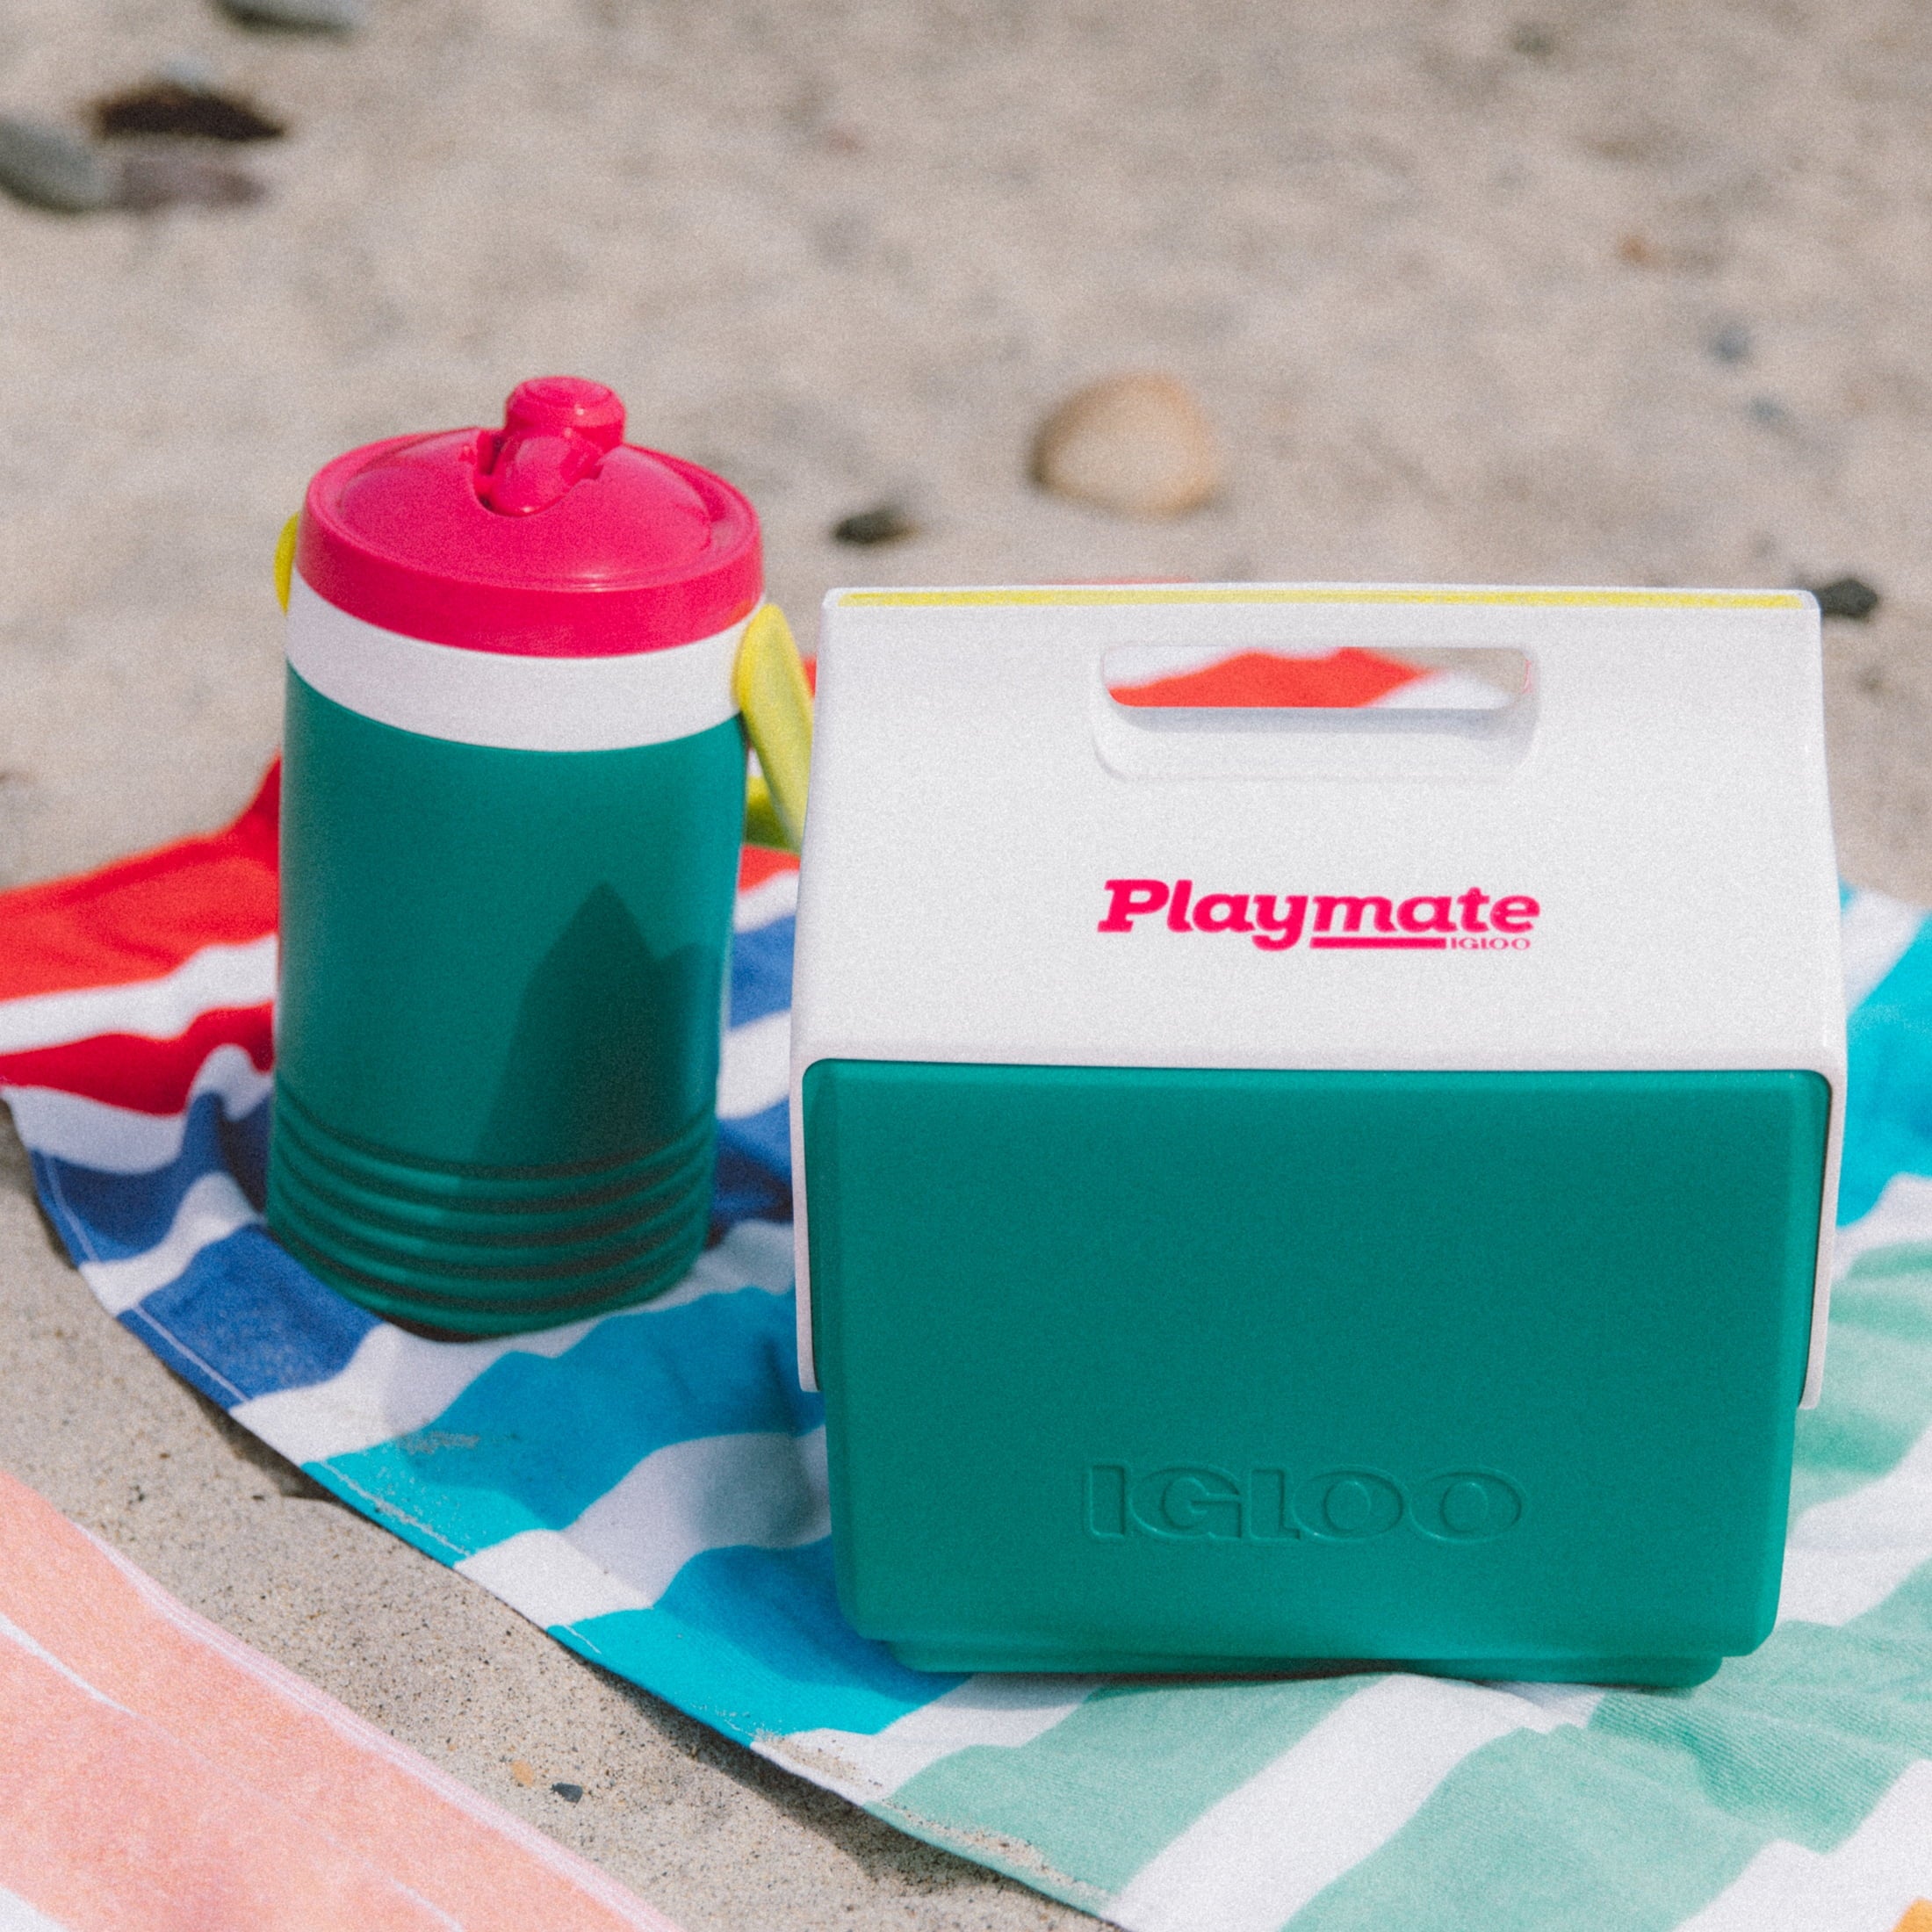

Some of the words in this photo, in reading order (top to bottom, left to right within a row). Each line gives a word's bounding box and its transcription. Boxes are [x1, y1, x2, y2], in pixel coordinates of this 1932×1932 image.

[1097, 878, 1540, 951] Playmate
[1451, 937, 1531, 950] IGLOO
[1085, 1461, 1526, 1543] IGLOO
